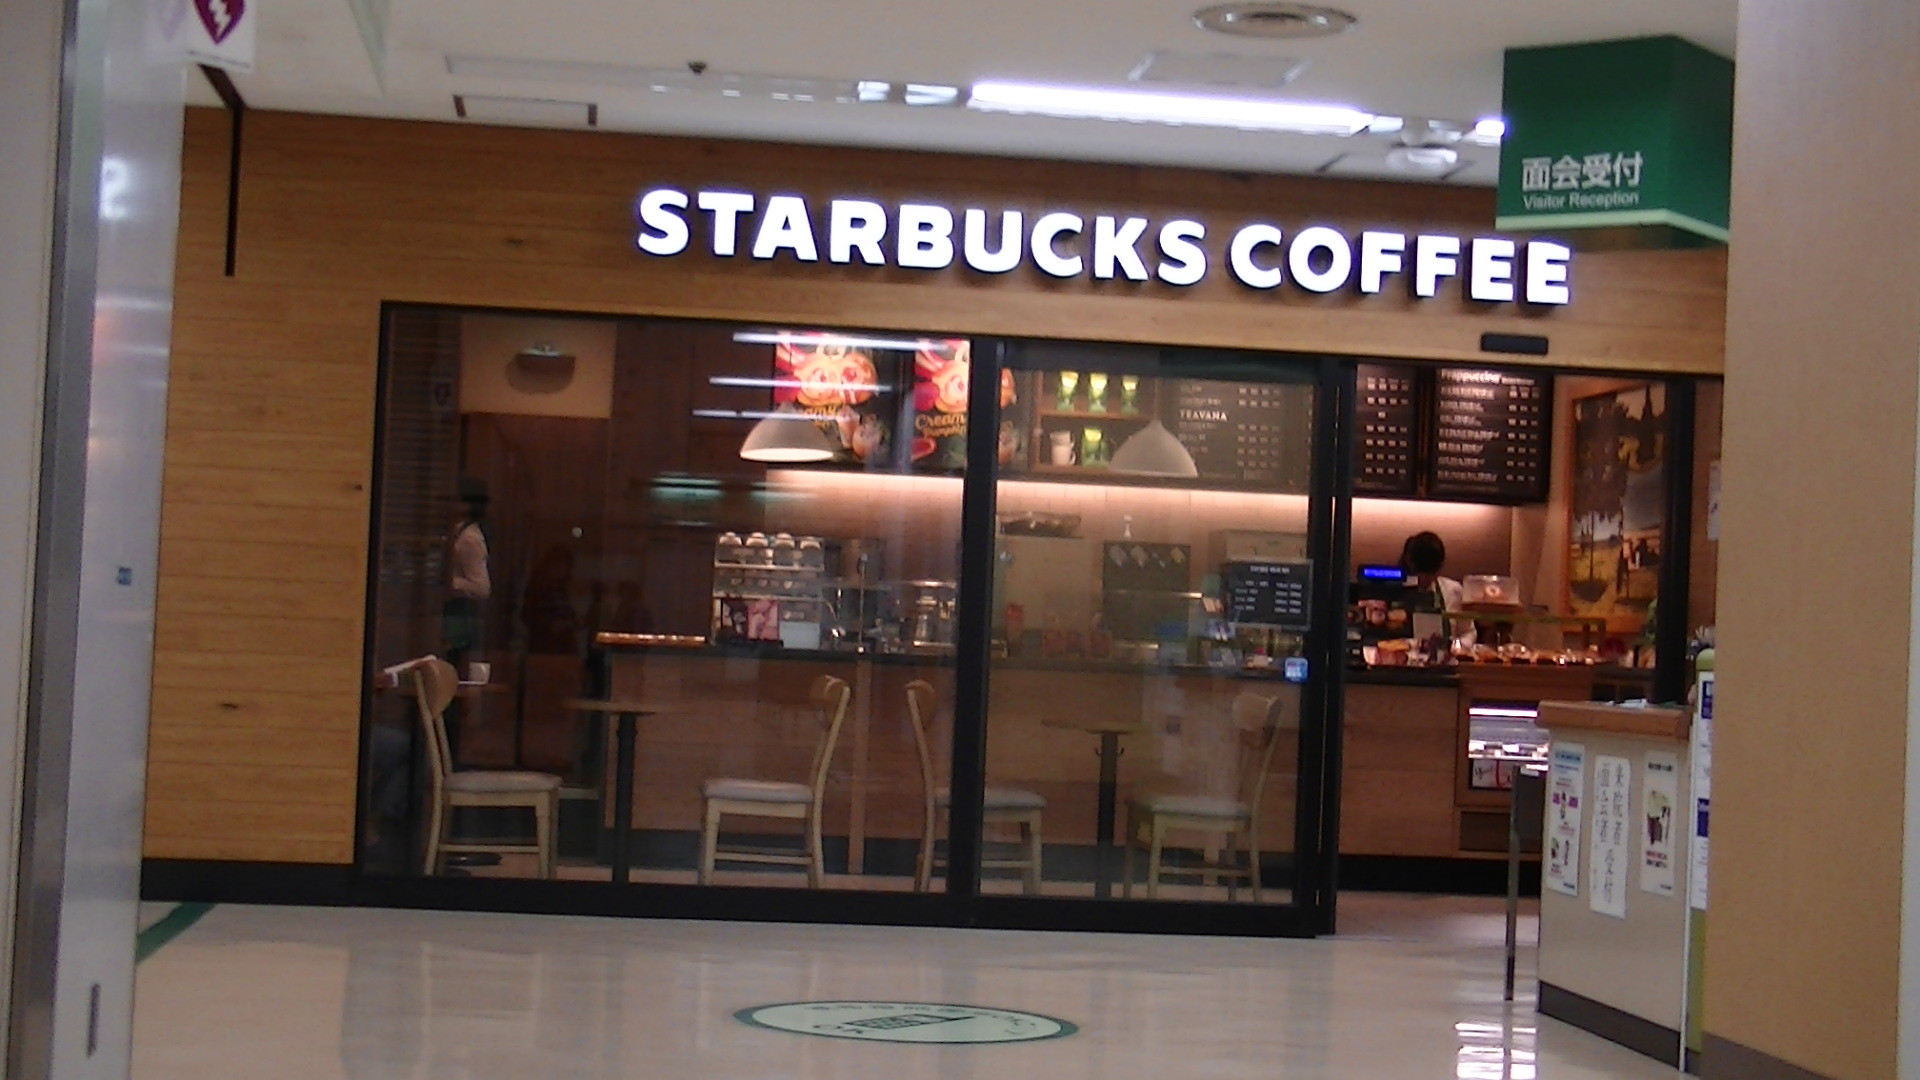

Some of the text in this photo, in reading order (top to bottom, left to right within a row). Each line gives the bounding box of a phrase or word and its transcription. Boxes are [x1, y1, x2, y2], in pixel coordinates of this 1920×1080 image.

[1521, 152, 1644, 191] 面会受付
[1523, 191, 1639, 210] Visitor Reception
[637, 188, 1572, 306] STARBUCKS COFFEE
[1179, 408, 1228, 422] TEAVANA
